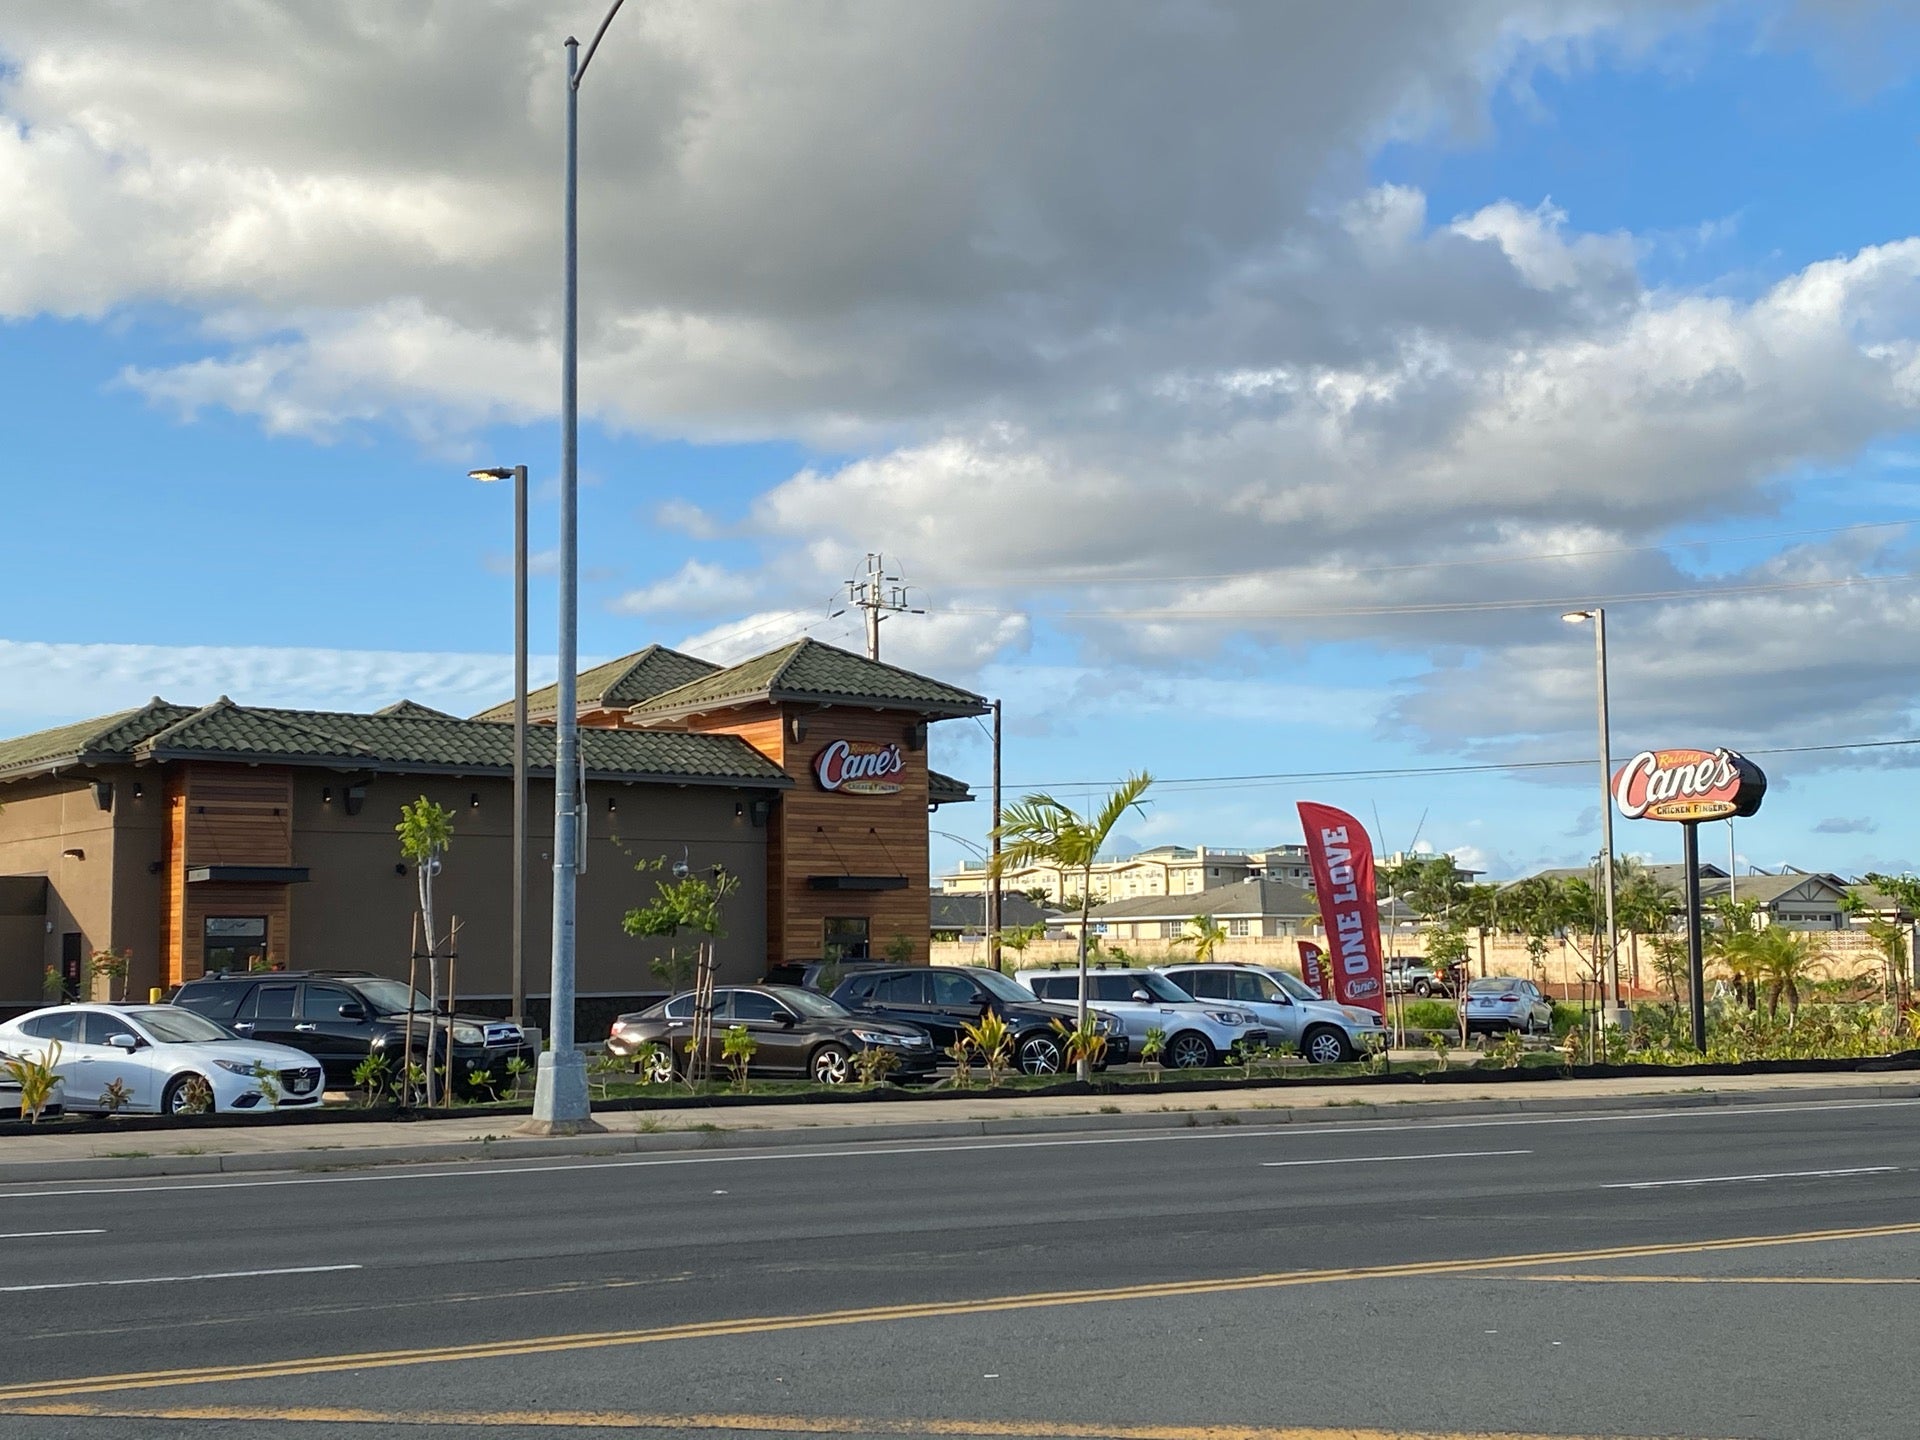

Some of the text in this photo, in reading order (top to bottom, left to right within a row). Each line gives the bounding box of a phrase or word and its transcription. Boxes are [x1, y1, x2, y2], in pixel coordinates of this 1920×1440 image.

[820, 740, 906, 790] Cane's
[1658, 753, 1700, 767] Raising
[1617, 748, 1738, 817] Cane's
[1656, 806, 1691, 815] CHICKEN
[1321, 826, 1370, 975] ONE LOVE
[1306, 950, 1320, 983] LOVE
